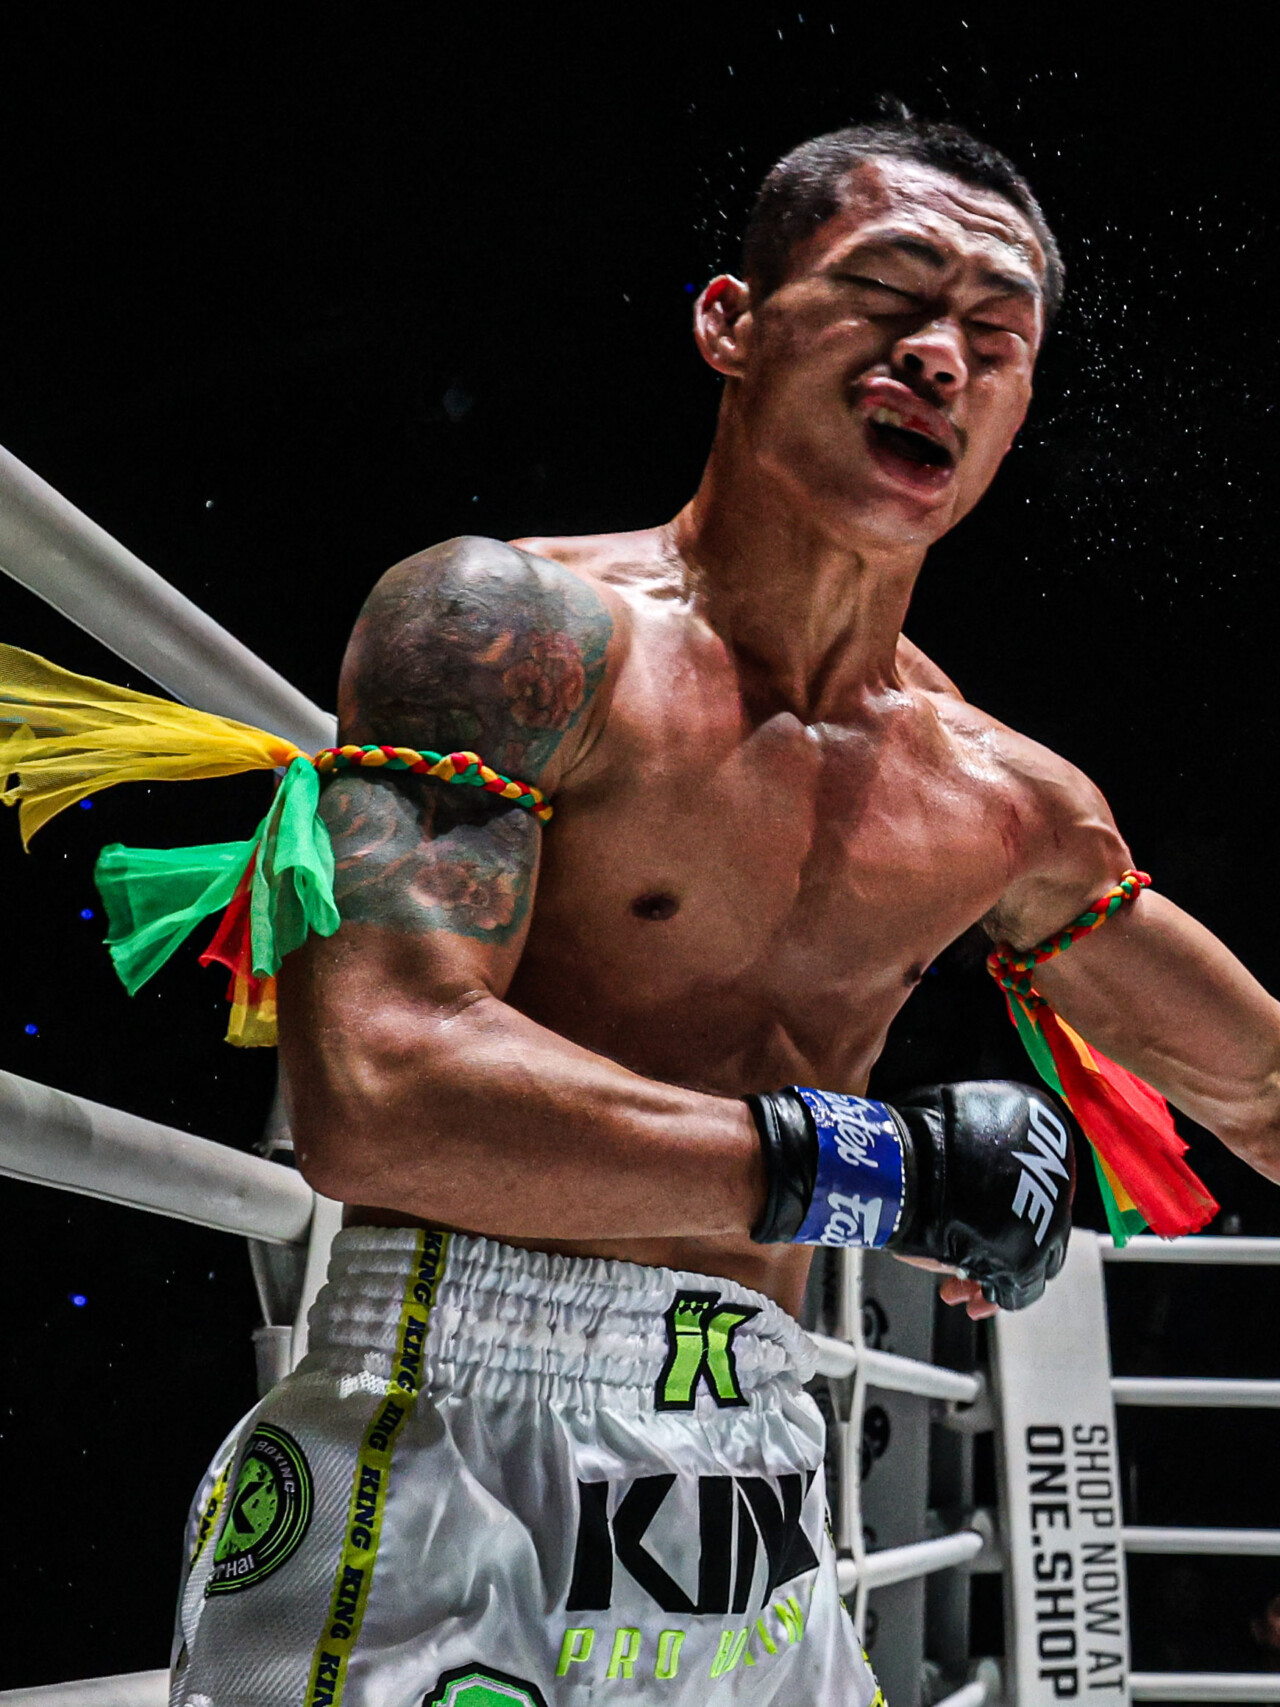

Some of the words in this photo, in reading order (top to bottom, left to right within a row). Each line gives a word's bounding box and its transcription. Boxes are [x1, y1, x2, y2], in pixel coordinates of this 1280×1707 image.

[1012, 1097, 1070, 1246] ONE
[413, 1231, 443, 1306] KING
[397, 1315, 426, 1393] KING
[368, 1400, 405, 1452] KING
[351, 1464, 382, 1551] KING
[1073, 1425, 1115, 1528] SHOP
[1026, 1425, 1079, 1700] ONE.SHOP
[1081, 1543, 1121, 1635] NOW
[330, 1564, 364, 1640] KING
[556, 1627, 686, 1680] PRO
[1086, 1650, 1125, 1694] AT
